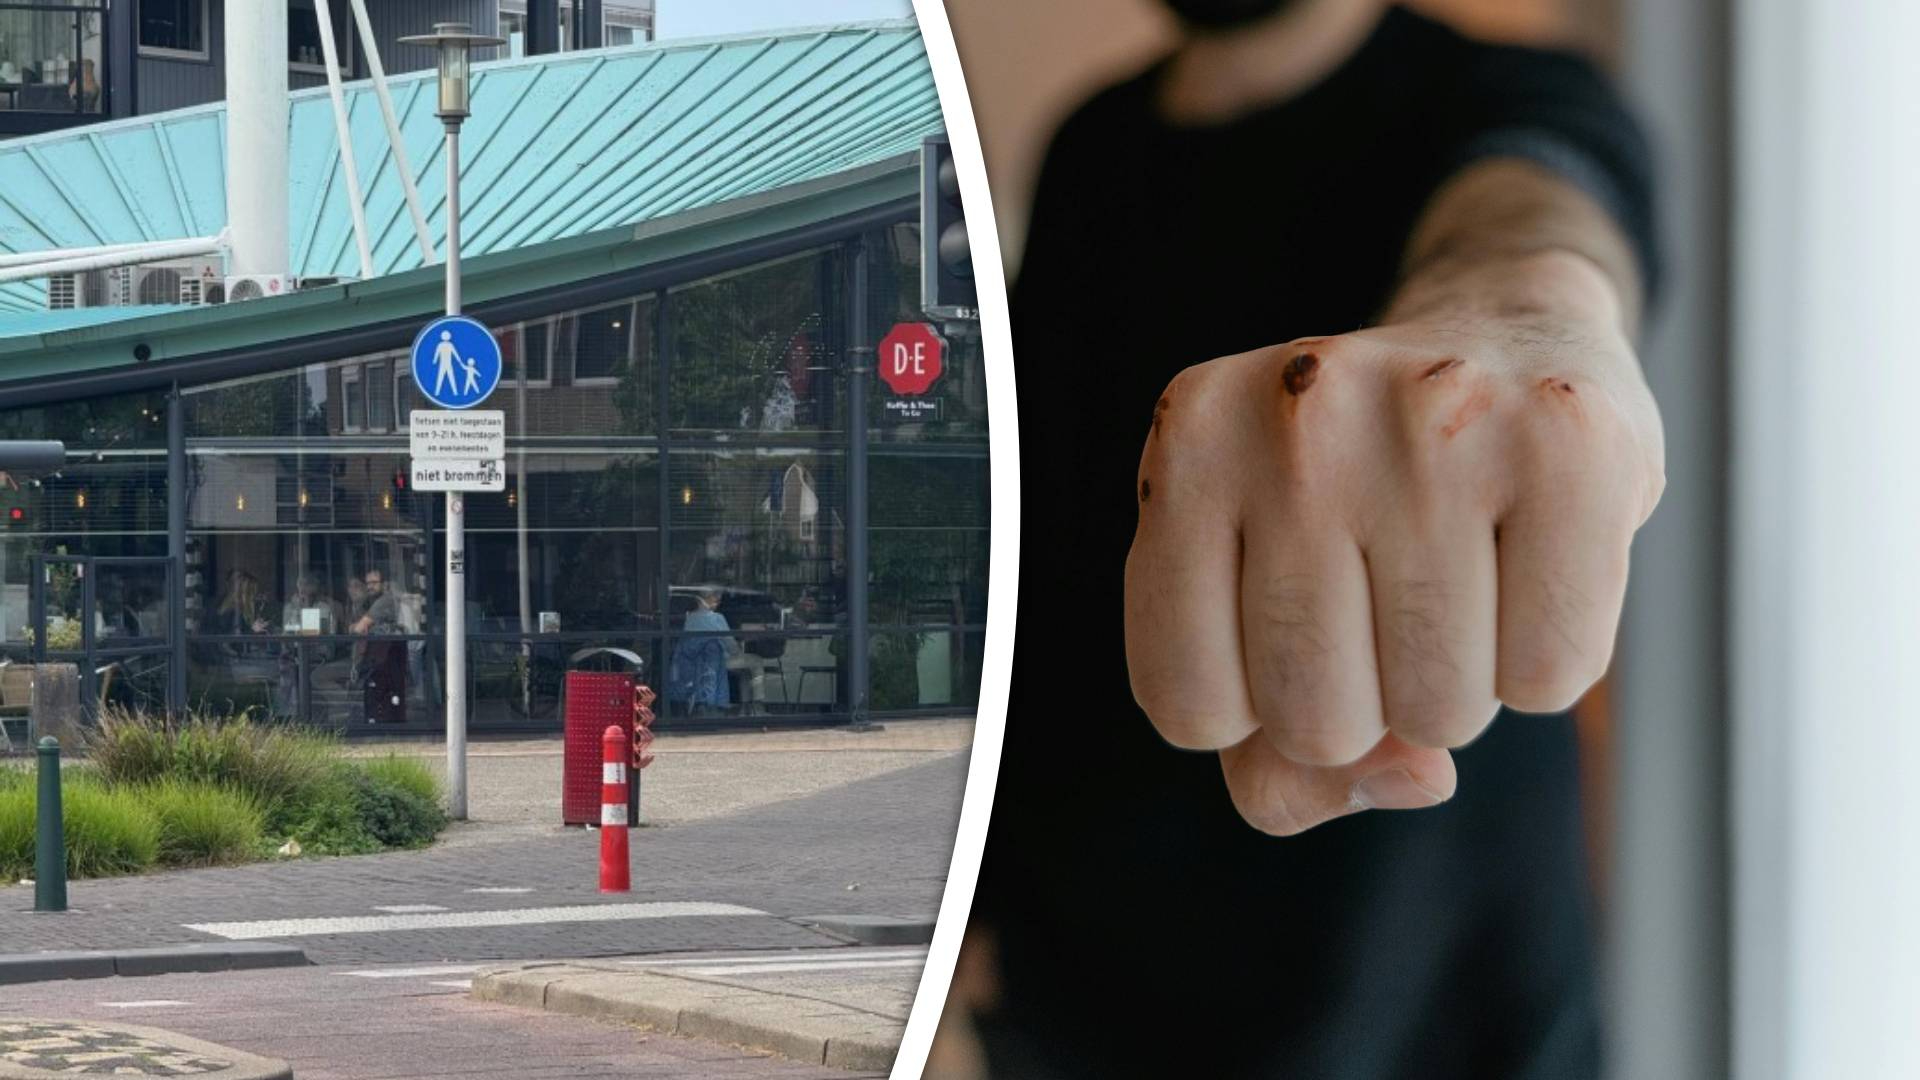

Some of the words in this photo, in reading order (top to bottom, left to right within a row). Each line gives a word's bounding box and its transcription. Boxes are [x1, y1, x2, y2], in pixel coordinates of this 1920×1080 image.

[910, 401, 916, 409] &
[918, 401, 935, 409] Thee
[443, 417, 458, 425] niet
[416, 469, 440, 481] niet
